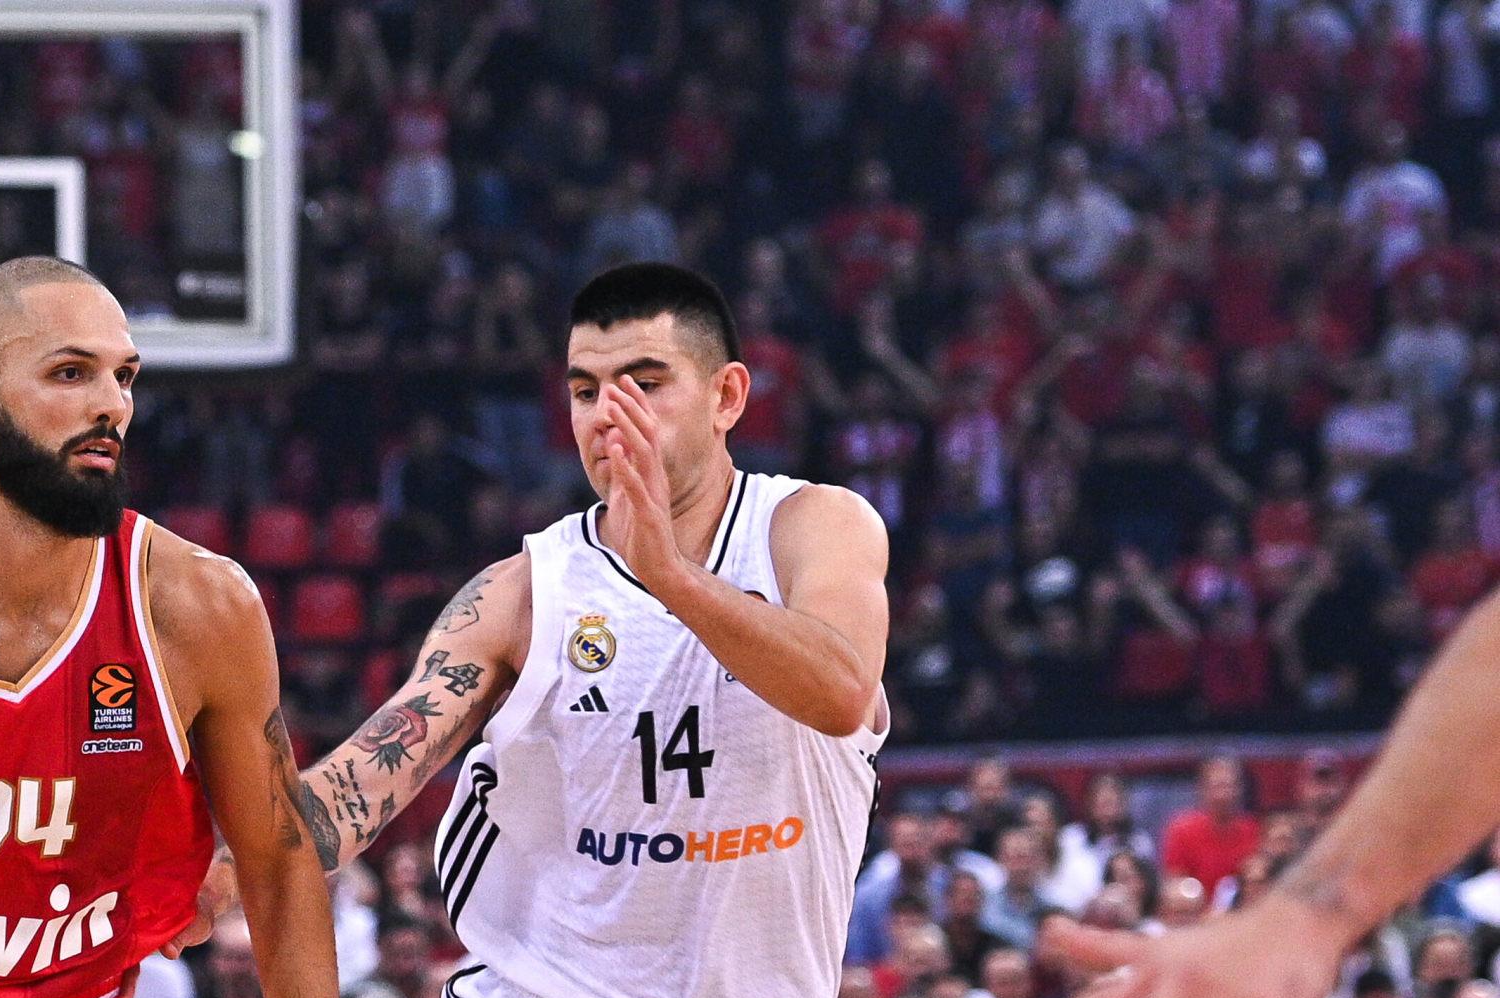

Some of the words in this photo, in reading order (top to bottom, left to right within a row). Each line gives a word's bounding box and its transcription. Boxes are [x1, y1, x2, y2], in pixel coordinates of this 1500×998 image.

[94, 708, 133, 716] TURKISH
[94, 715, 133, 723] AIRLINES
[94, 723, 133, 731] EuroLeague
[632, 705, 715, 805] 14
[576, 816, 804, 867] AUTOHERO
